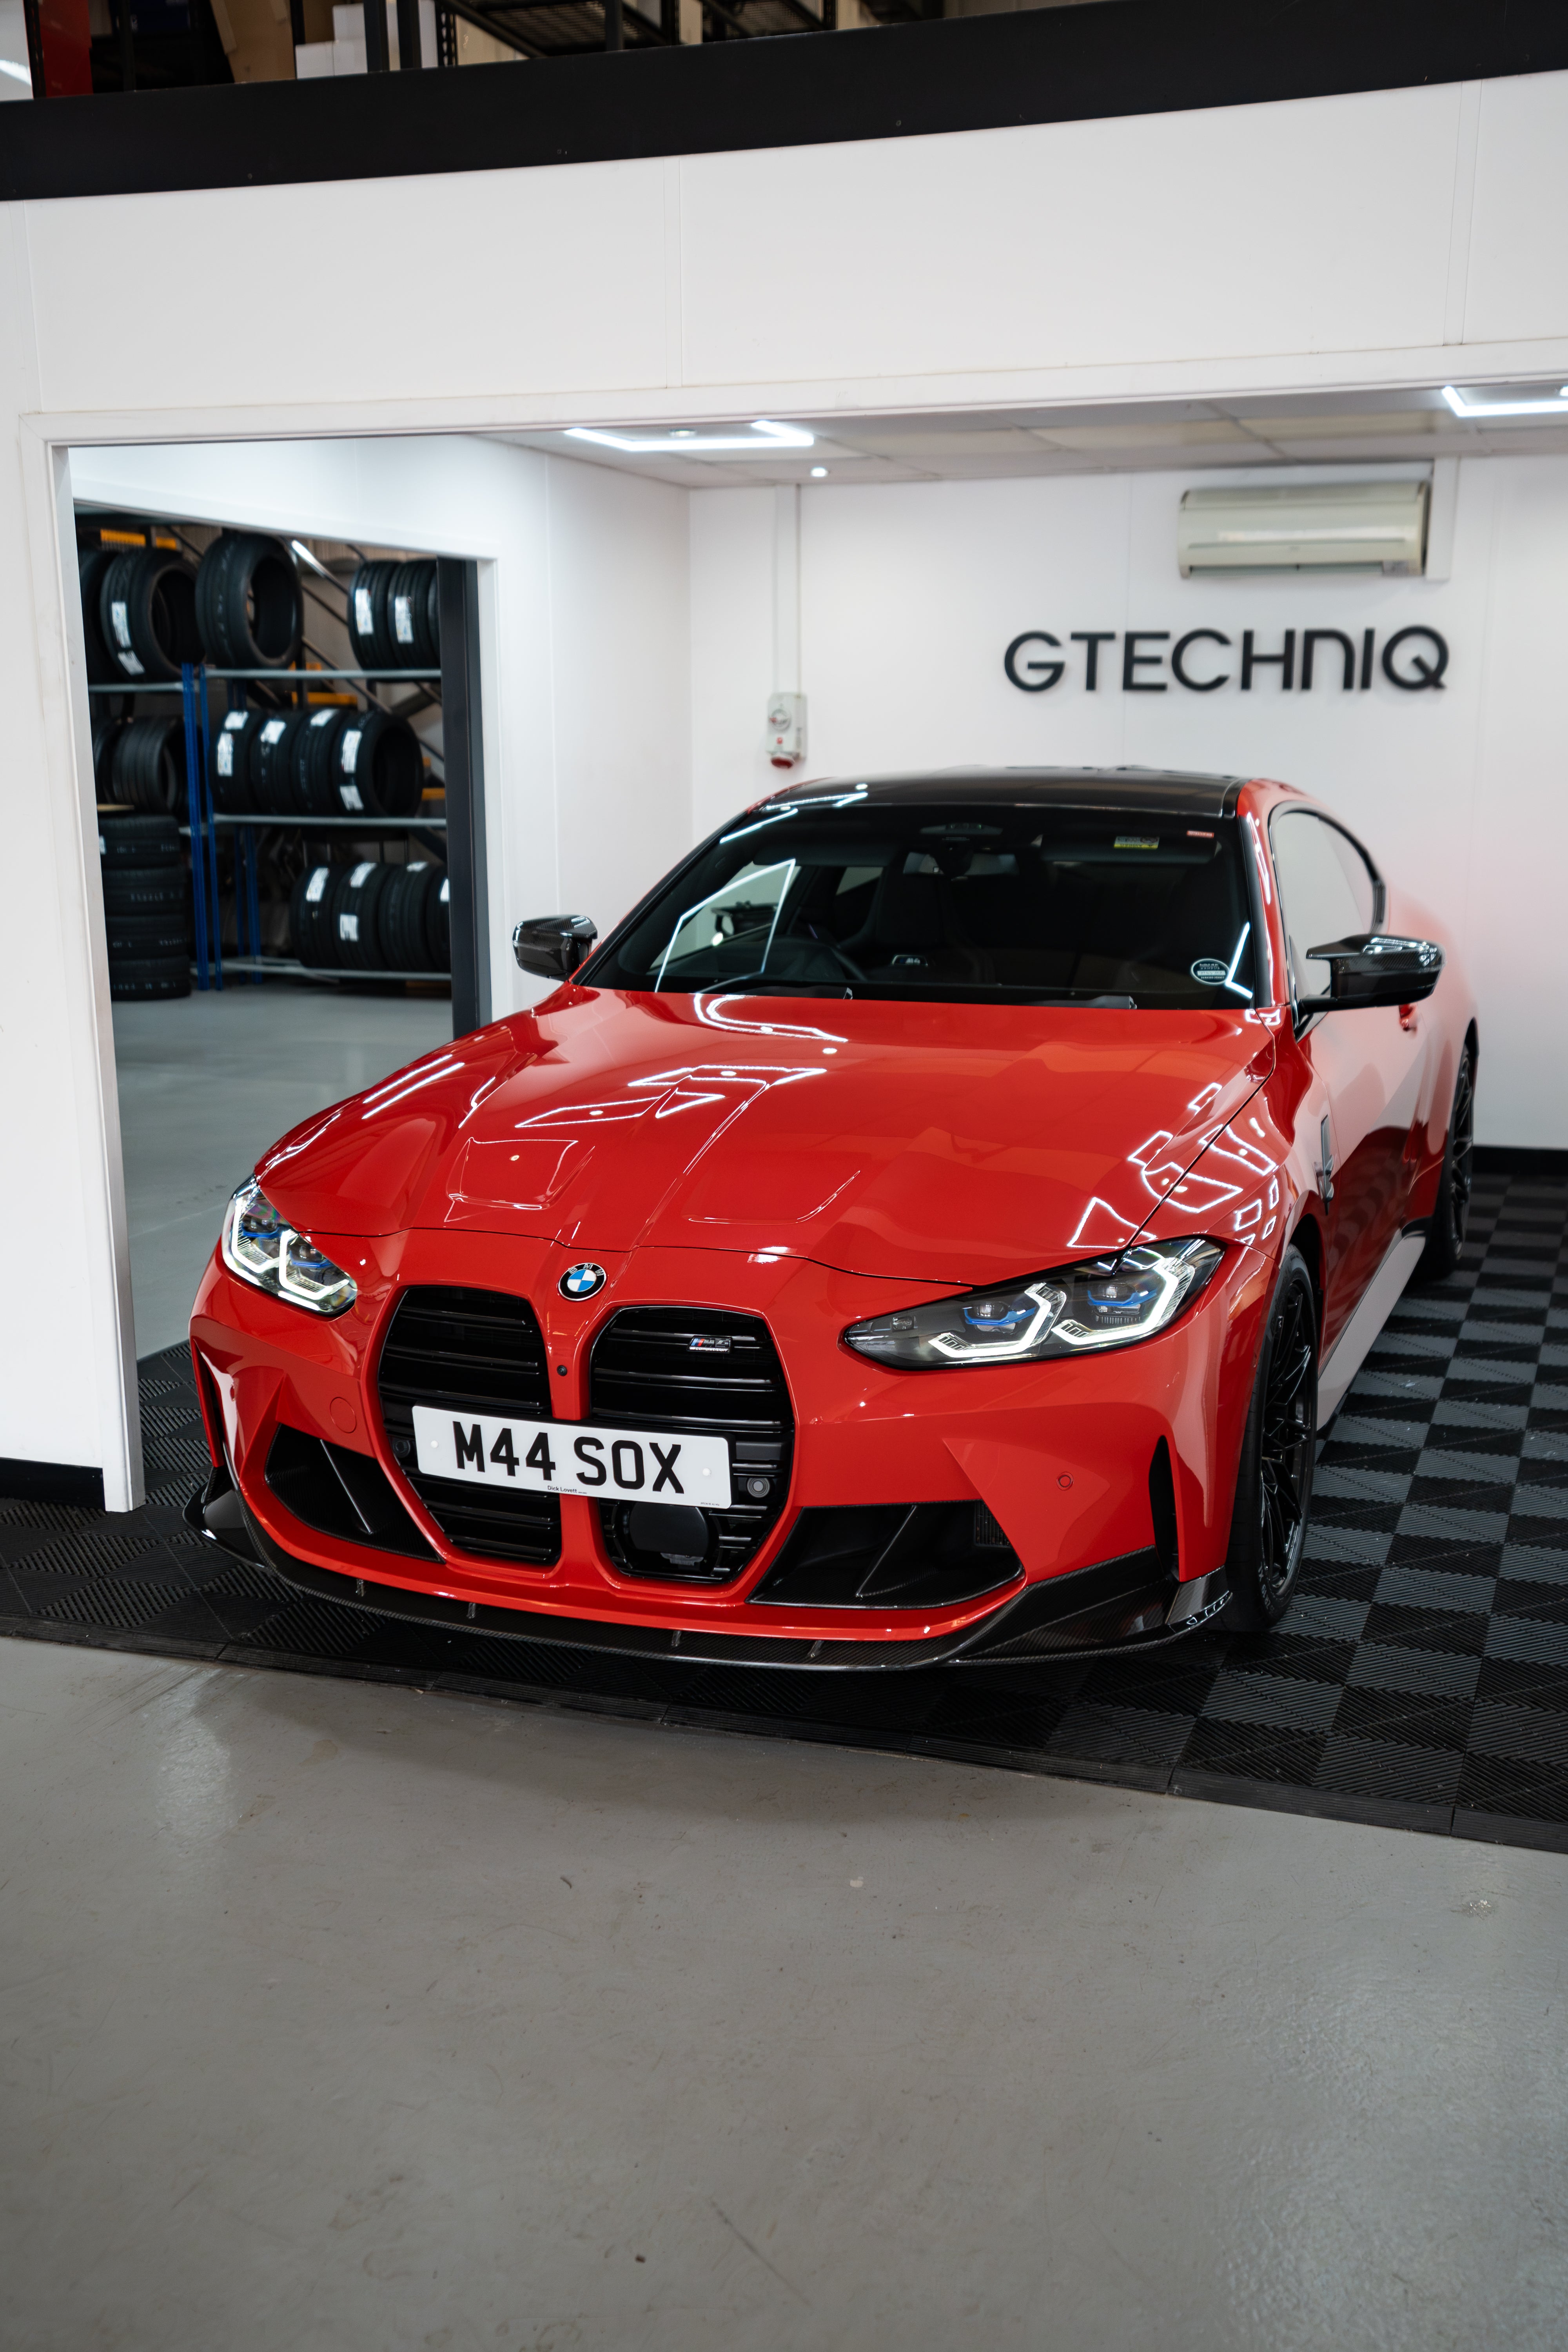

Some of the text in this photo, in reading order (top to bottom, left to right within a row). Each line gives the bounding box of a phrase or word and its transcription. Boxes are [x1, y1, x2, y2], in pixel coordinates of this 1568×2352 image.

[1004, 625, 1449, 693] GTECHNIQ
[568, 1263, 604, 1276] BMW
[452, 1421, 684, 1494] M44 SOX
